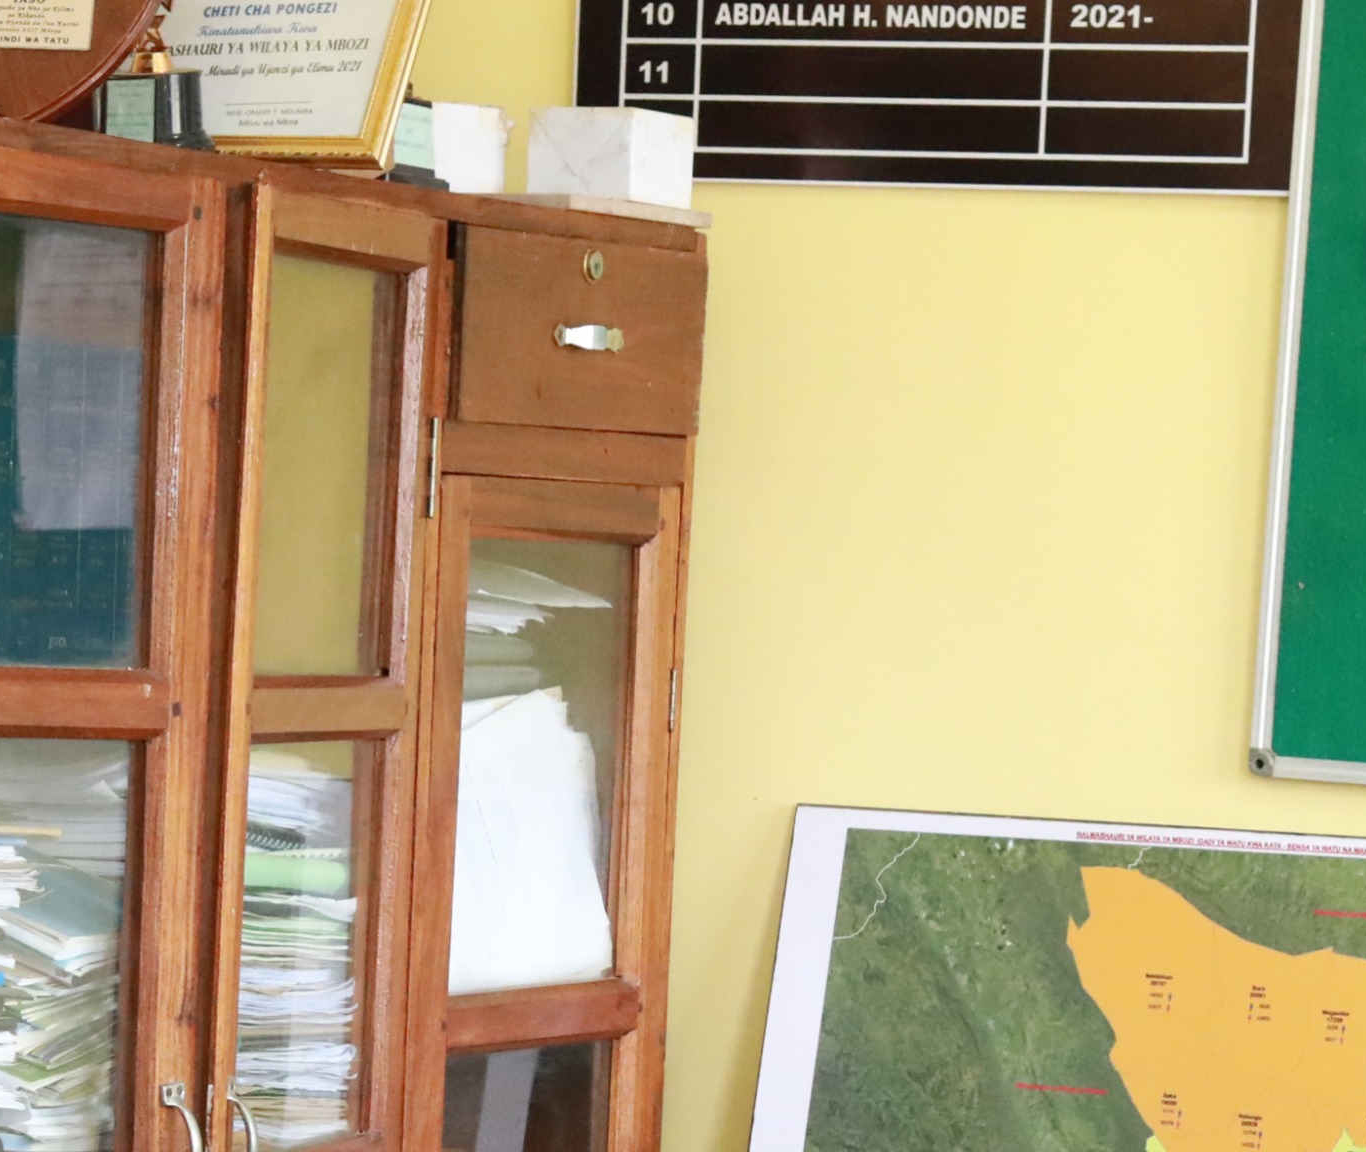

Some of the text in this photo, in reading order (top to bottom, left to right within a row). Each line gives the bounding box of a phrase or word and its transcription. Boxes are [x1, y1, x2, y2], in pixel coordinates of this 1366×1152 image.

[203, 1, 338, 18] CHETI CHA PONGEZI
[642, 1, 1153, 30] 10 ABDALLAH H. NANDONDE 2021-
[196, 21, 319, 38] Kinatunukiwa Kwa
[26, 36, 40, 44] WA
[44, 37, 70, 45] TATU
[228, 43, 244, 55] YA
[249, 41, 300, 55] WILAYA
[305, 41, 322, 53] YA
[327, 38, 371, 52] MBOZI
[638, 61, 669, 84] 11
